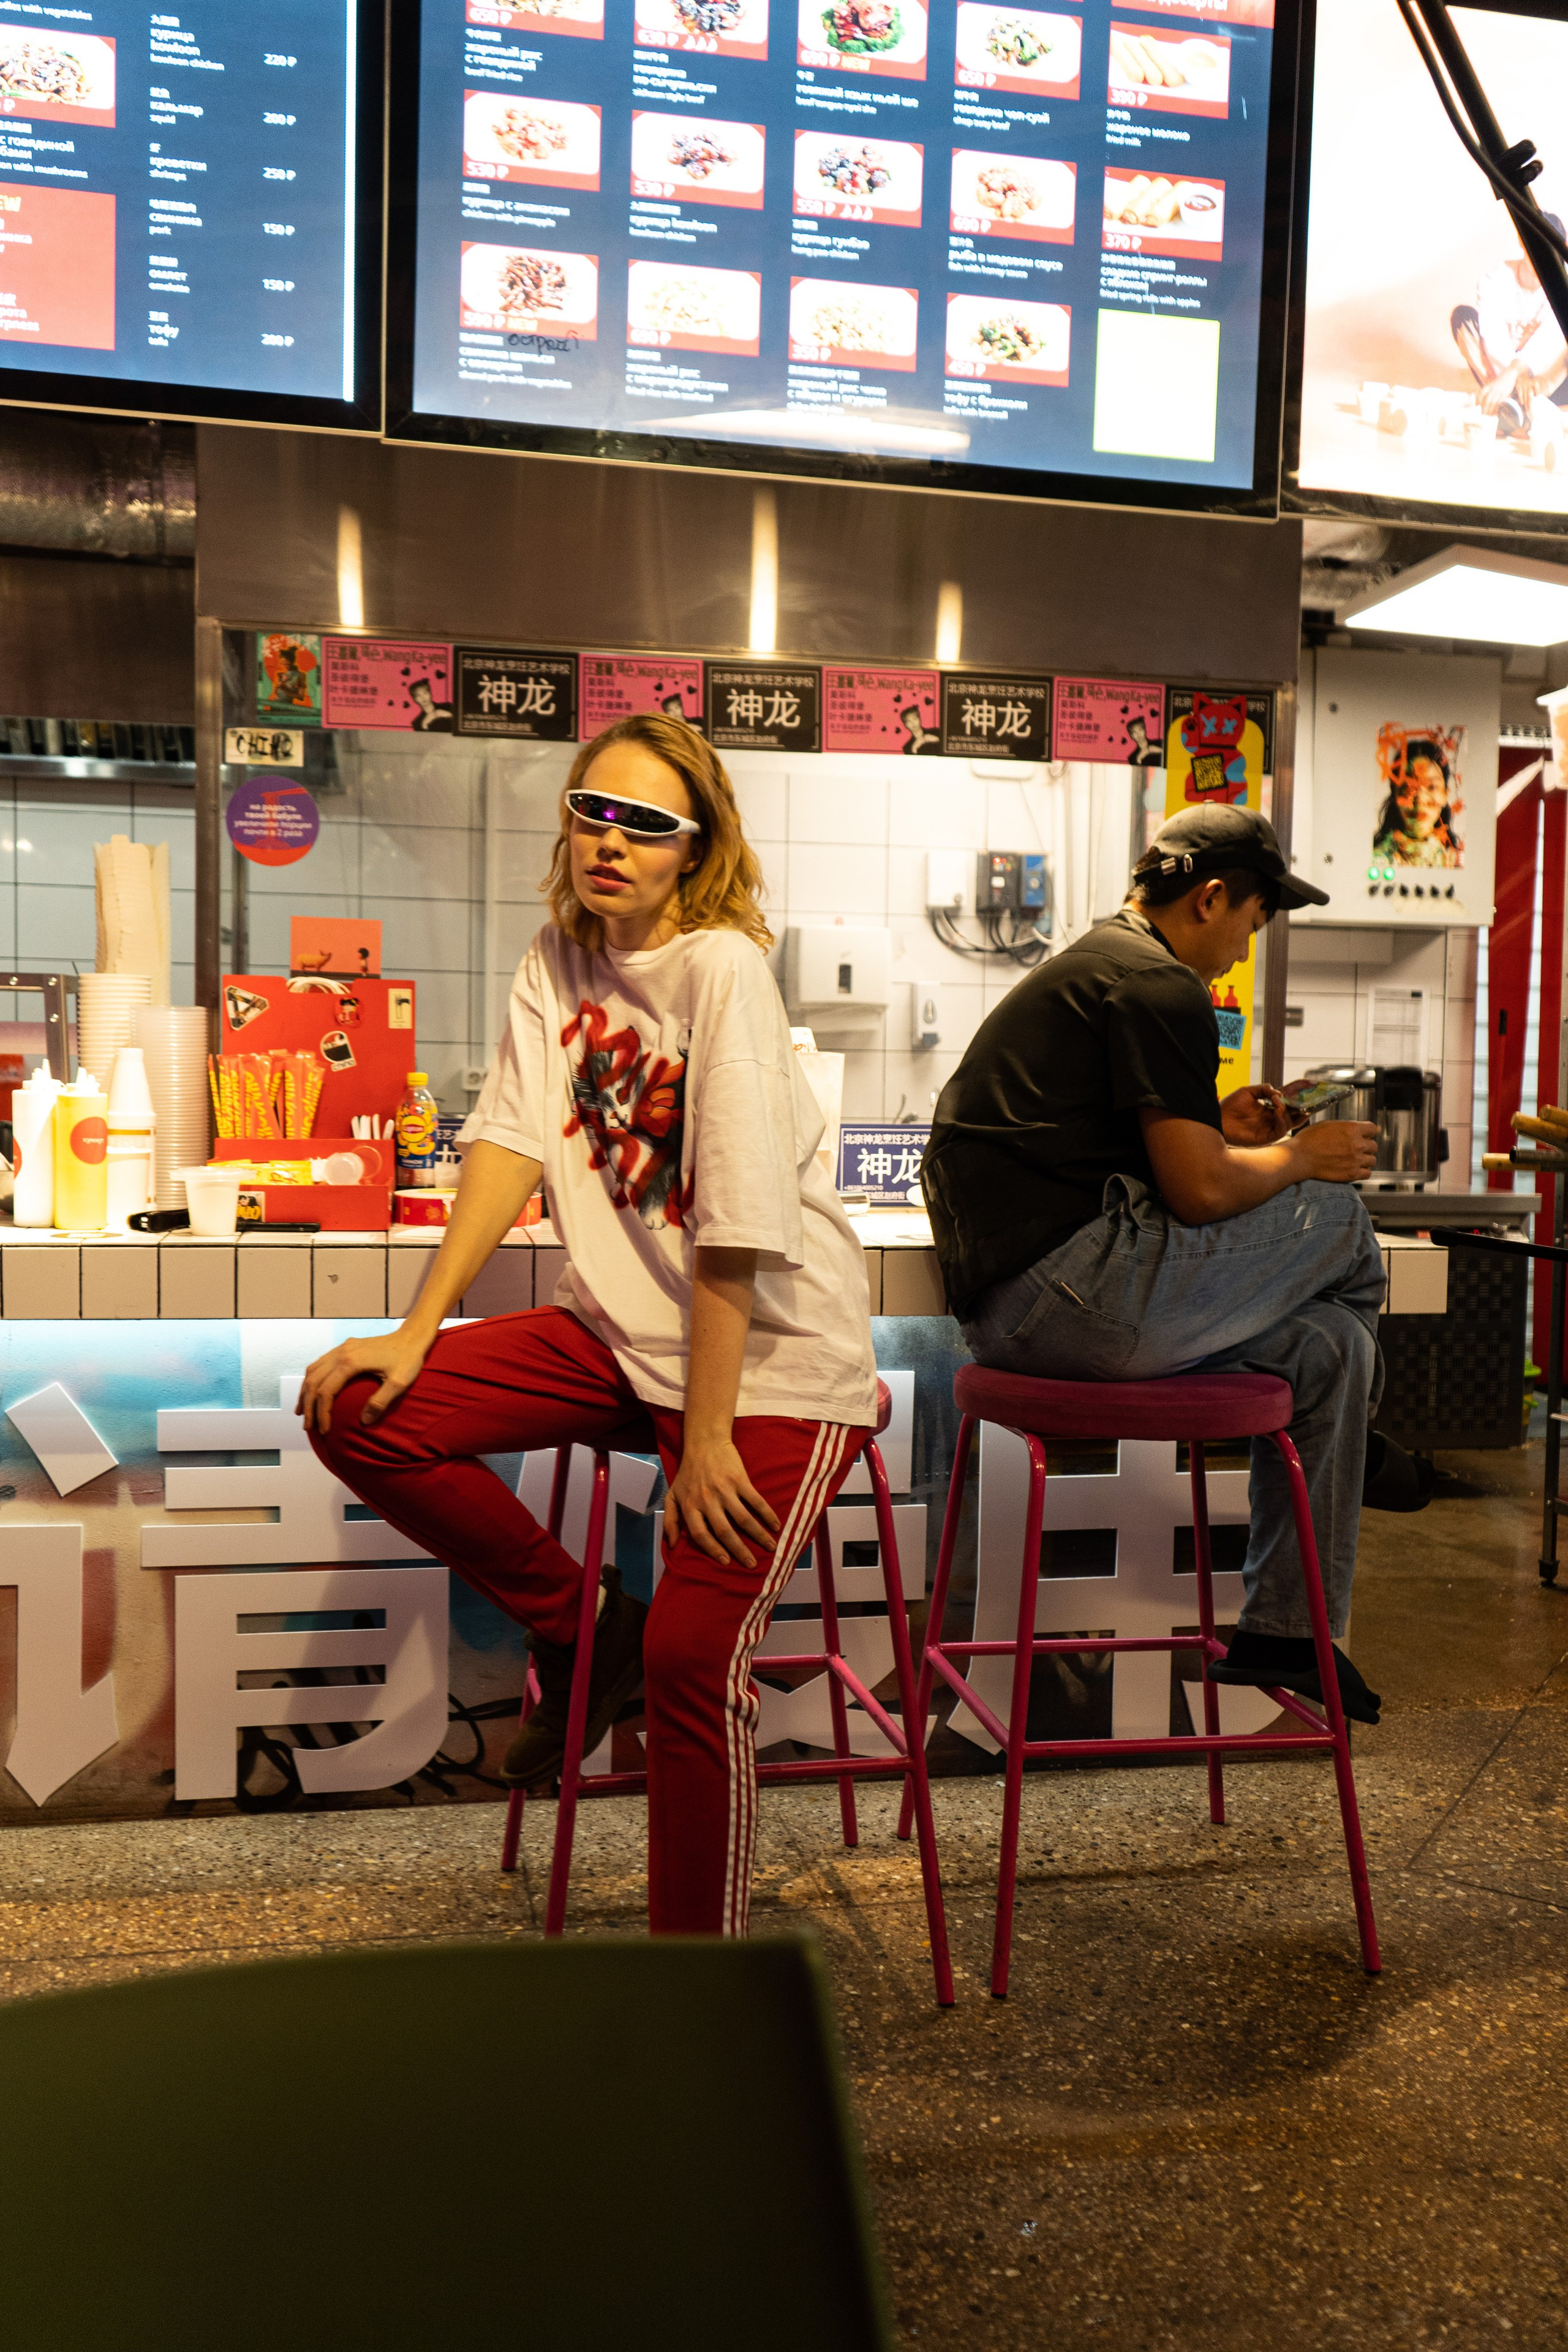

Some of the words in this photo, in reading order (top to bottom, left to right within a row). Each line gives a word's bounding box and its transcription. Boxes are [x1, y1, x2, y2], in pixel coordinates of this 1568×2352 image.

[150, 29, 195, 43] курица
[1152, 128, 1190, 141] молоко
[0, 146, 32, 159] бами
[0, 195, 21, 211] EW
[262, 223, 284, 235] 150
[1106, 233, 1130, 249] 370
[262, 279, 284, 291] 150
[0, 319, 39, 331] rpness
[148, 323, 179, 338] тофу
[478, 674, 556, 715] 神龙
[726, 688, 801, 727] 神龙
[962, 698, 1031, 737] 神龙
[844, 1134, 930, 1145] 北京神龙烹饪艺术学
[857, 1148, 923, 1184] 神龙
